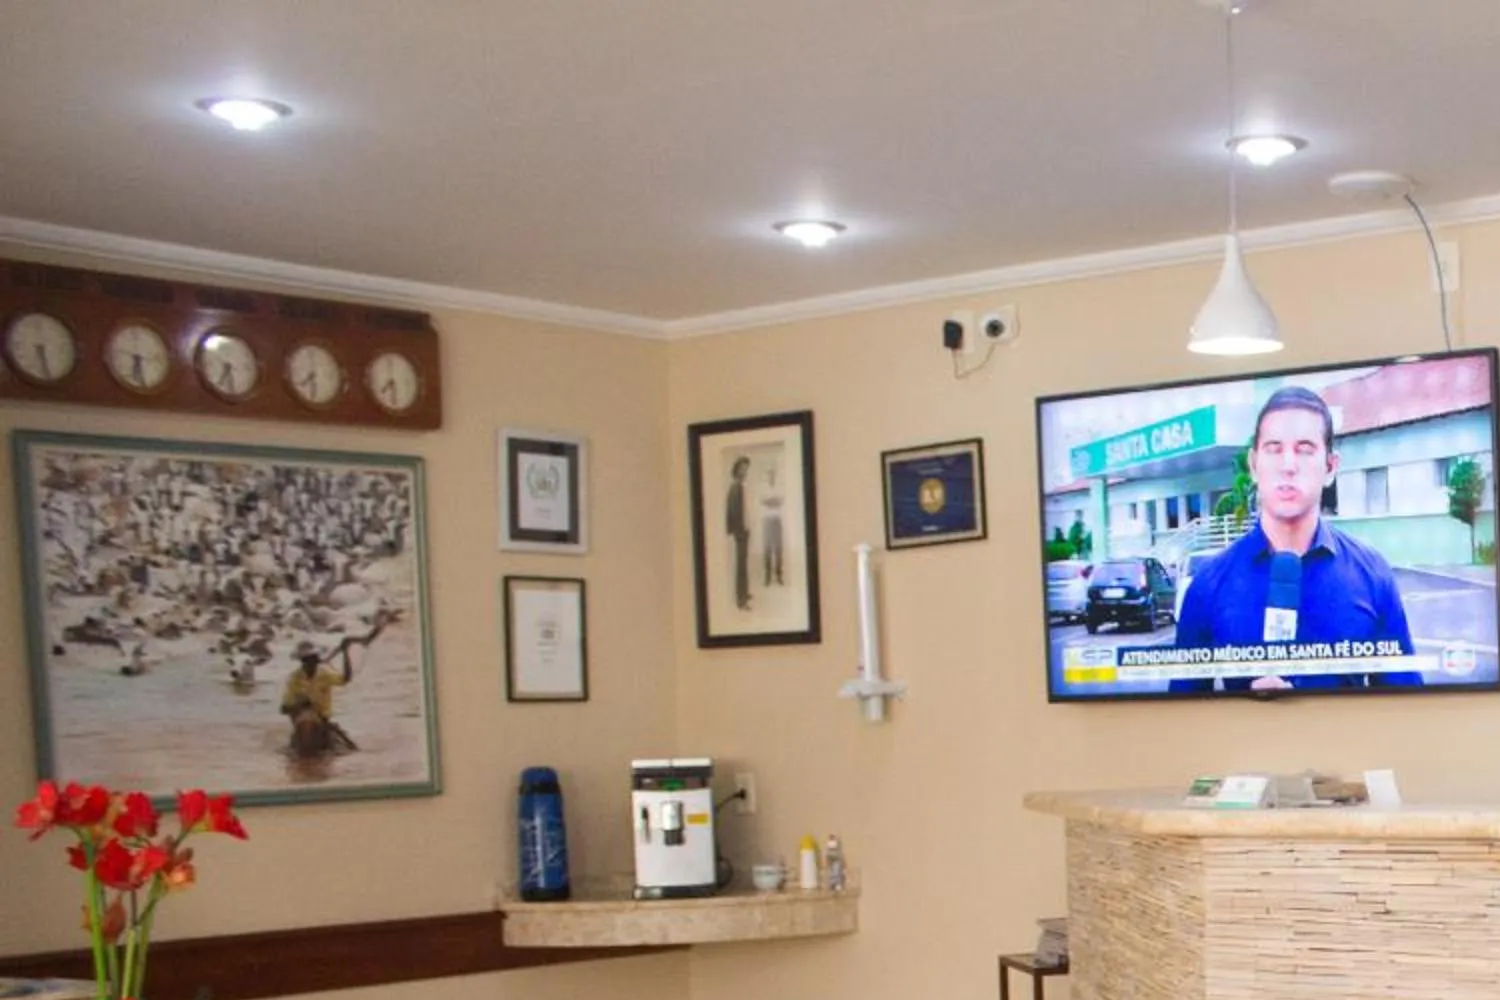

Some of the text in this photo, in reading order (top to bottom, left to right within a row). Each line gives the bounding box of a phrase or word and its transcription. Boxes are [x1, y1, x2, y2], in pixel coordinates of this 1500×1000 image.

[1105, 419, 1194, 468] SANTA CASA
[1121, 647, 1211, 666] ATENDIMENTO
[1213, 643, 1265, 662] MÉDICO
[1267, 644, 1288, 660] EM
[1289, 642, 1333, 659] SANTA
[1352, 640, 1375, 657] DO
[1376, 639, 1404, 656] SUL
